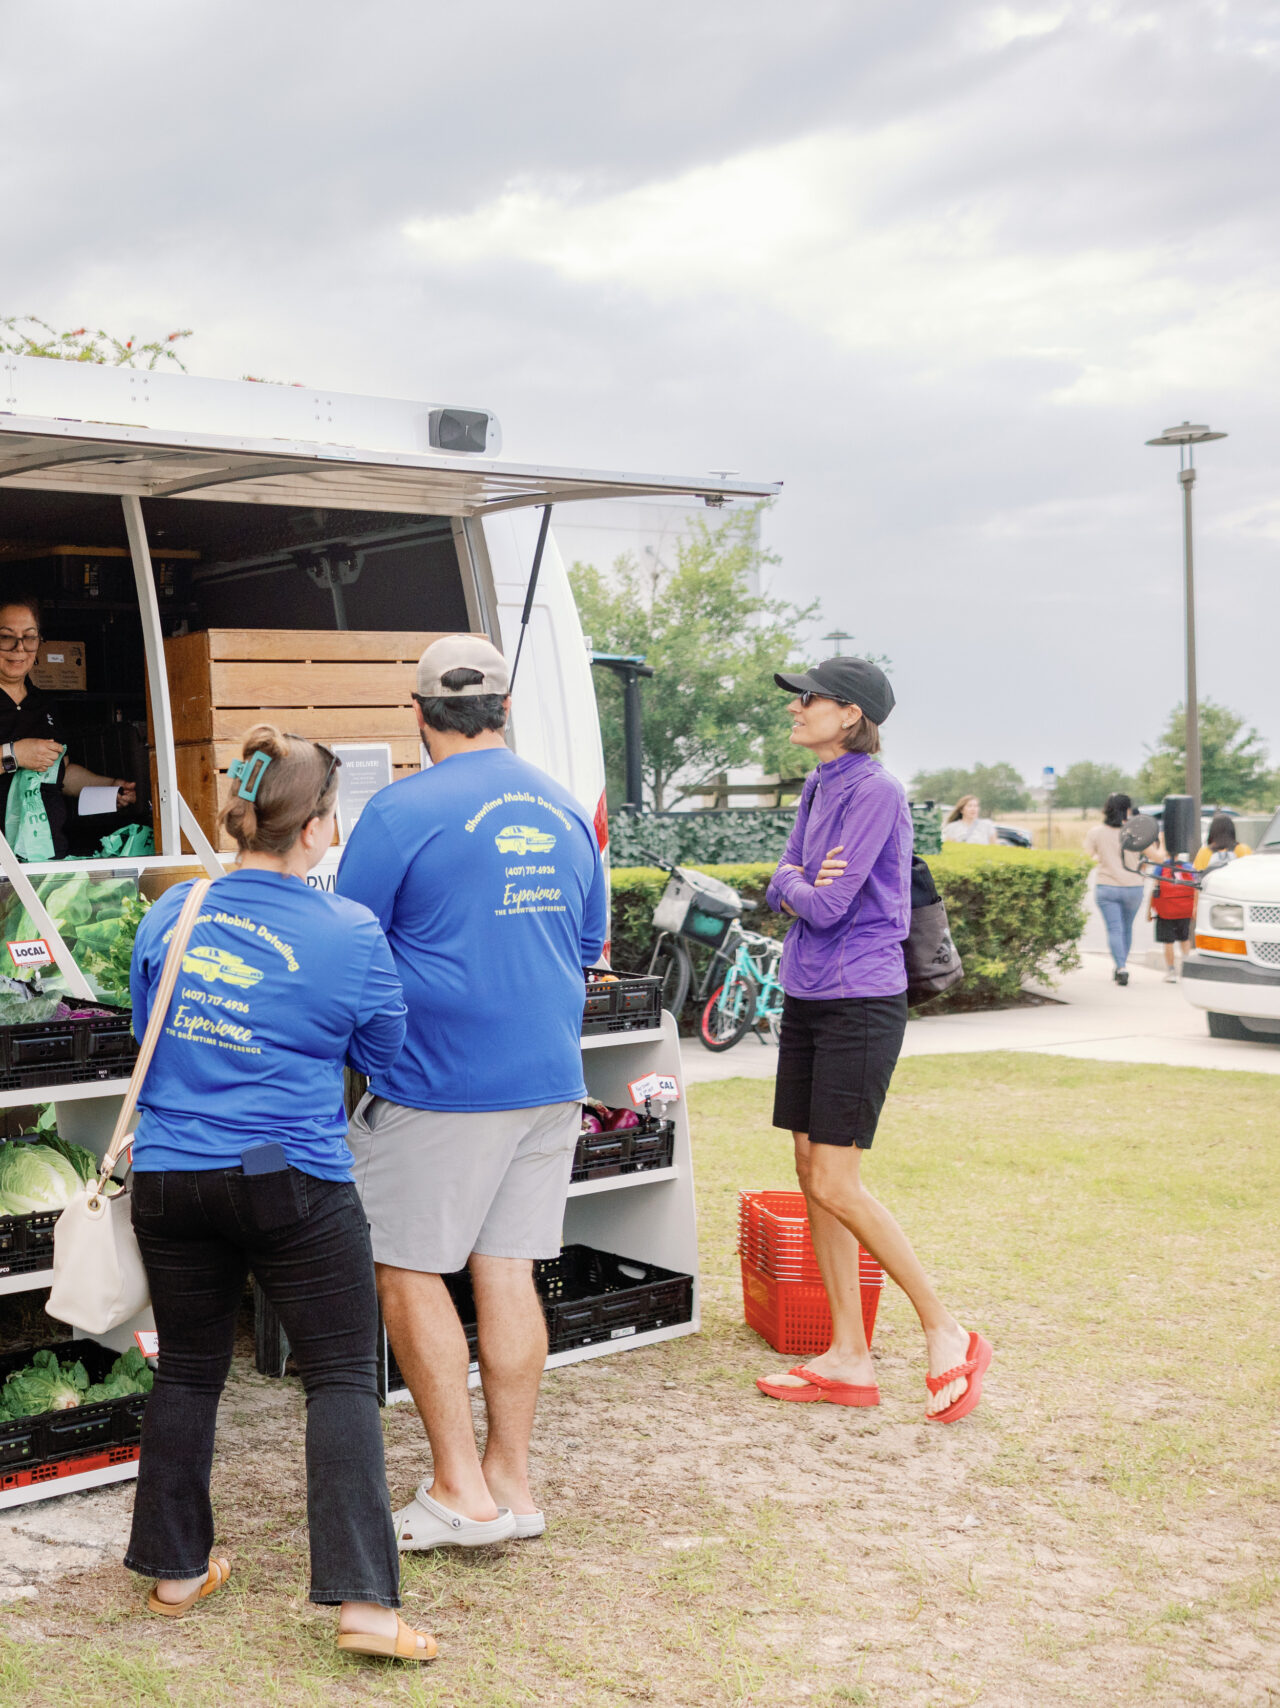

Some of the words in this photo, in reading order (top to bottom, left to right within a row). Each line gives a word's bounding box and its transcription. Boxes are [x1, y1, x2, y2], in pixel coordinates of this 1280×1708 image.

[345, 760, 355, 768] WE
[464, 797, 503, 833] Showtime
[503, 790, 536, 803] Mobile
[537, 796, 572, 831] Detailing
[505, 865, 526, 878] (407)
[525, 865, 555, 875] 717-6936
[503, 883, 562, 910] Experience
[537, 905, 566, 913] DIFFERENCE
[14, 946, 46, 957] LOCAL
[213, 912, 256, 932] Mobile
[257, 925, 300, 972] Detailing
[181, 987, 206, 1004] (407)
[207, 994, 250, 1014] 717-6936
[173, 1004, 253, 1042] Experience
[177, 1030, 217, 1046] SHOWTIME
[218, 1041, 261, 1054] DIFFERENCE
[660, 1081, 674, 1089] CAL
